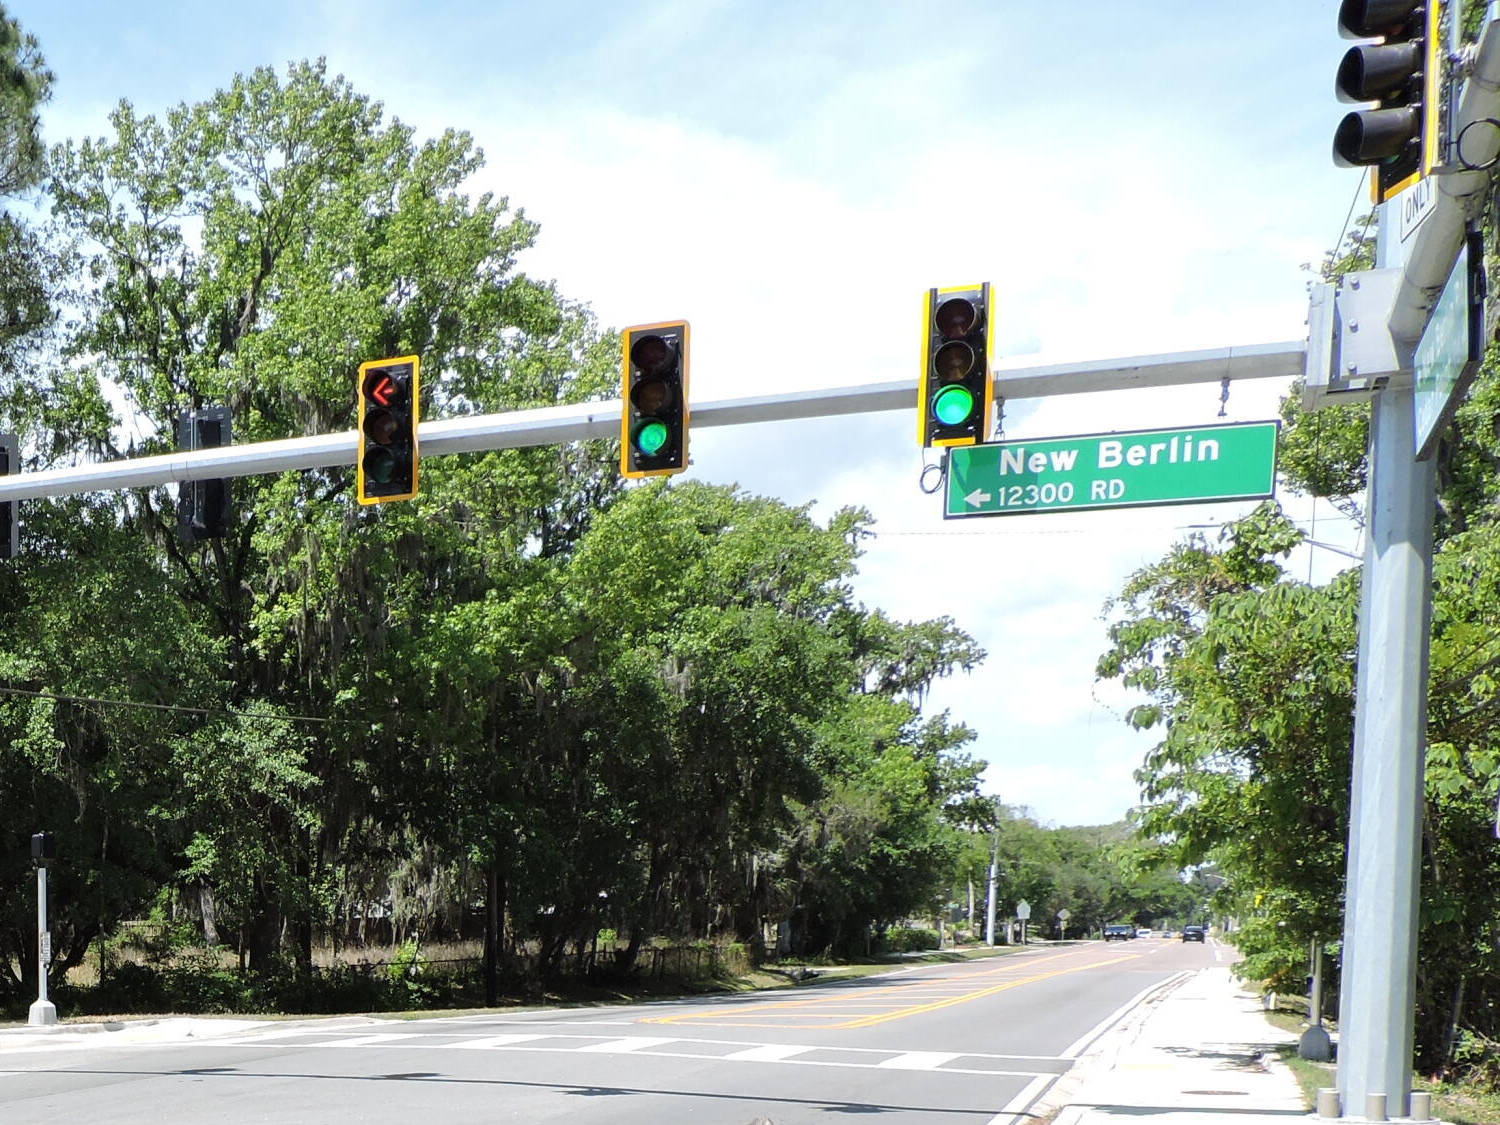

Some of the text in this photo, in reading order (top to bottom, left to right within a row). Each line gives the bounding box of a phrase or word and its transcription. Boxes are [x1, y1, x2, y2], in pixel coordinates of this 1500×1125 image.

[1406, 175, 1431, 224] ONLY
[999, 434, 1220, 475] New Berlin
[998, 479, 1125, 507] 12300 RD
